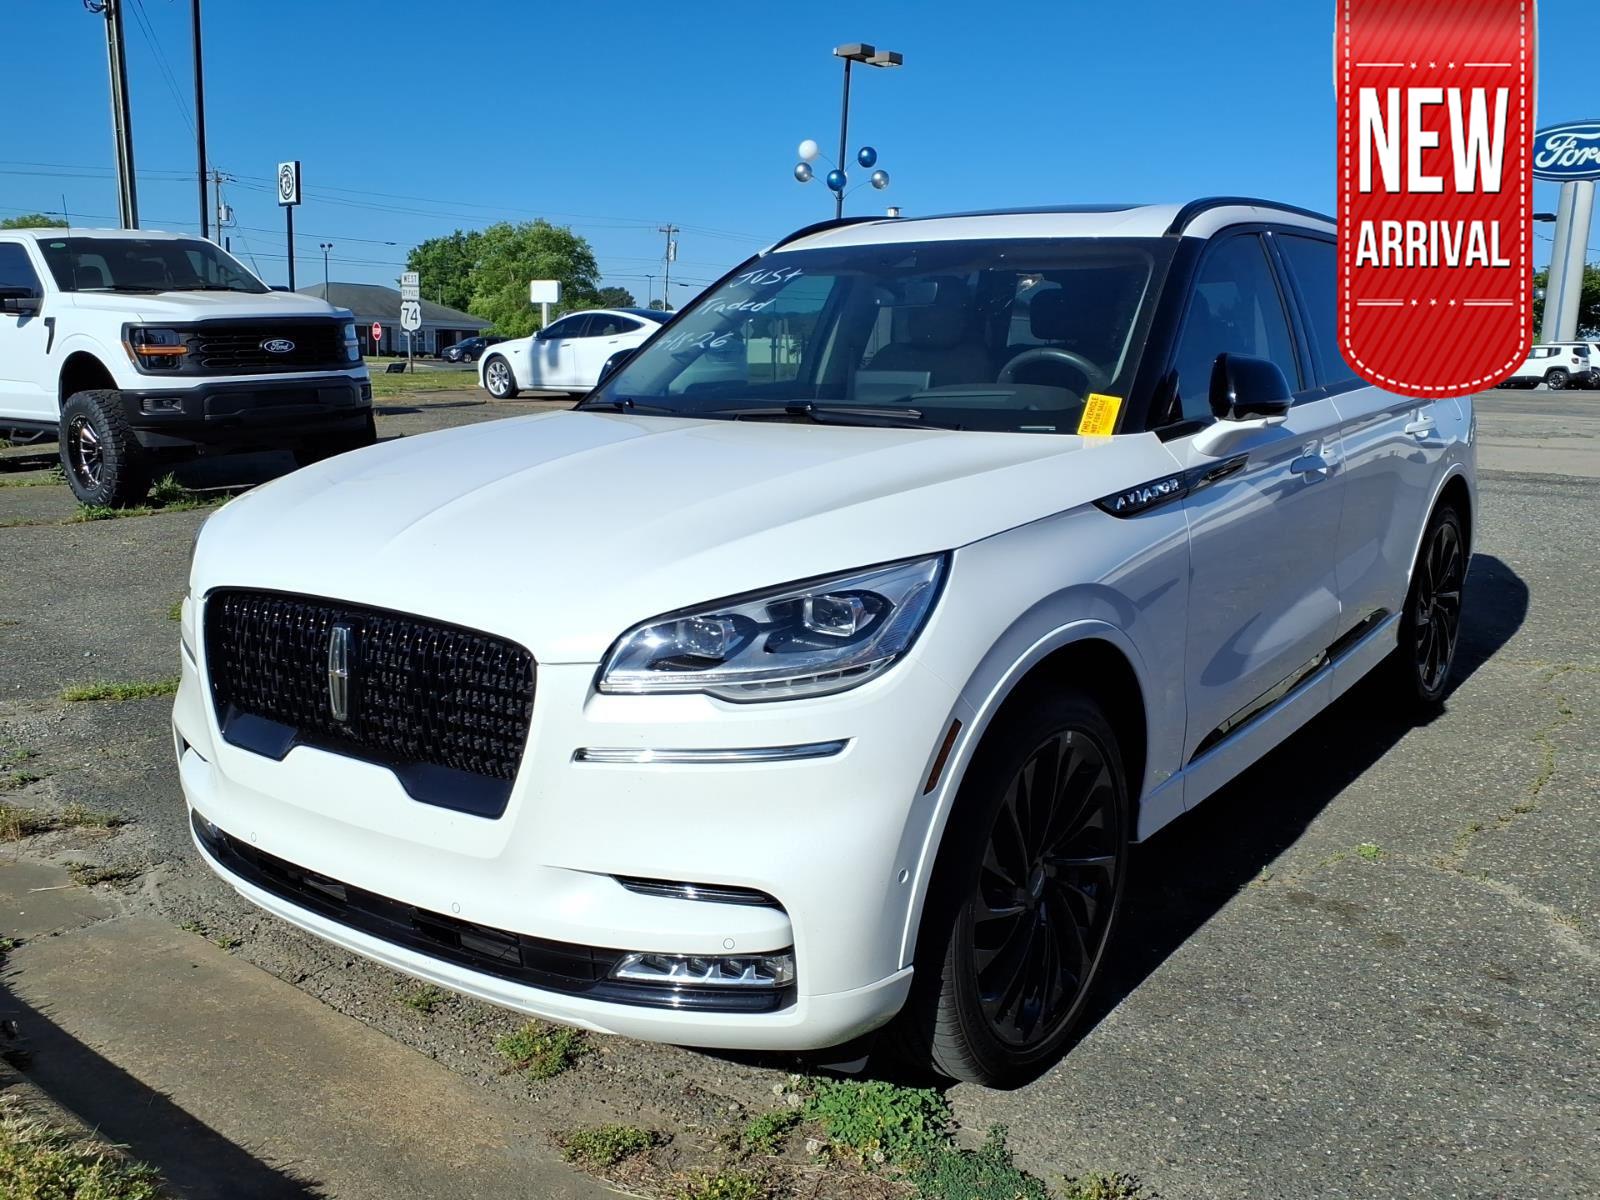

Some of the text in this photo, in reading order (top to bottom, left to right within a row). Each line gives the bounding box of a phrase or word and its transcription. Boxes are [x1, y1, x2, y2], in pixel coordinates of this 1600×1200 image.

[1534, 132, 1600, 168] For
[403, 274, 417, 283] WEST
[402, 307, 418, 325] 74
[1086, 396, 1099, 420] VEHICLE
[1115, 478, 1180, 510] AVIATOR
